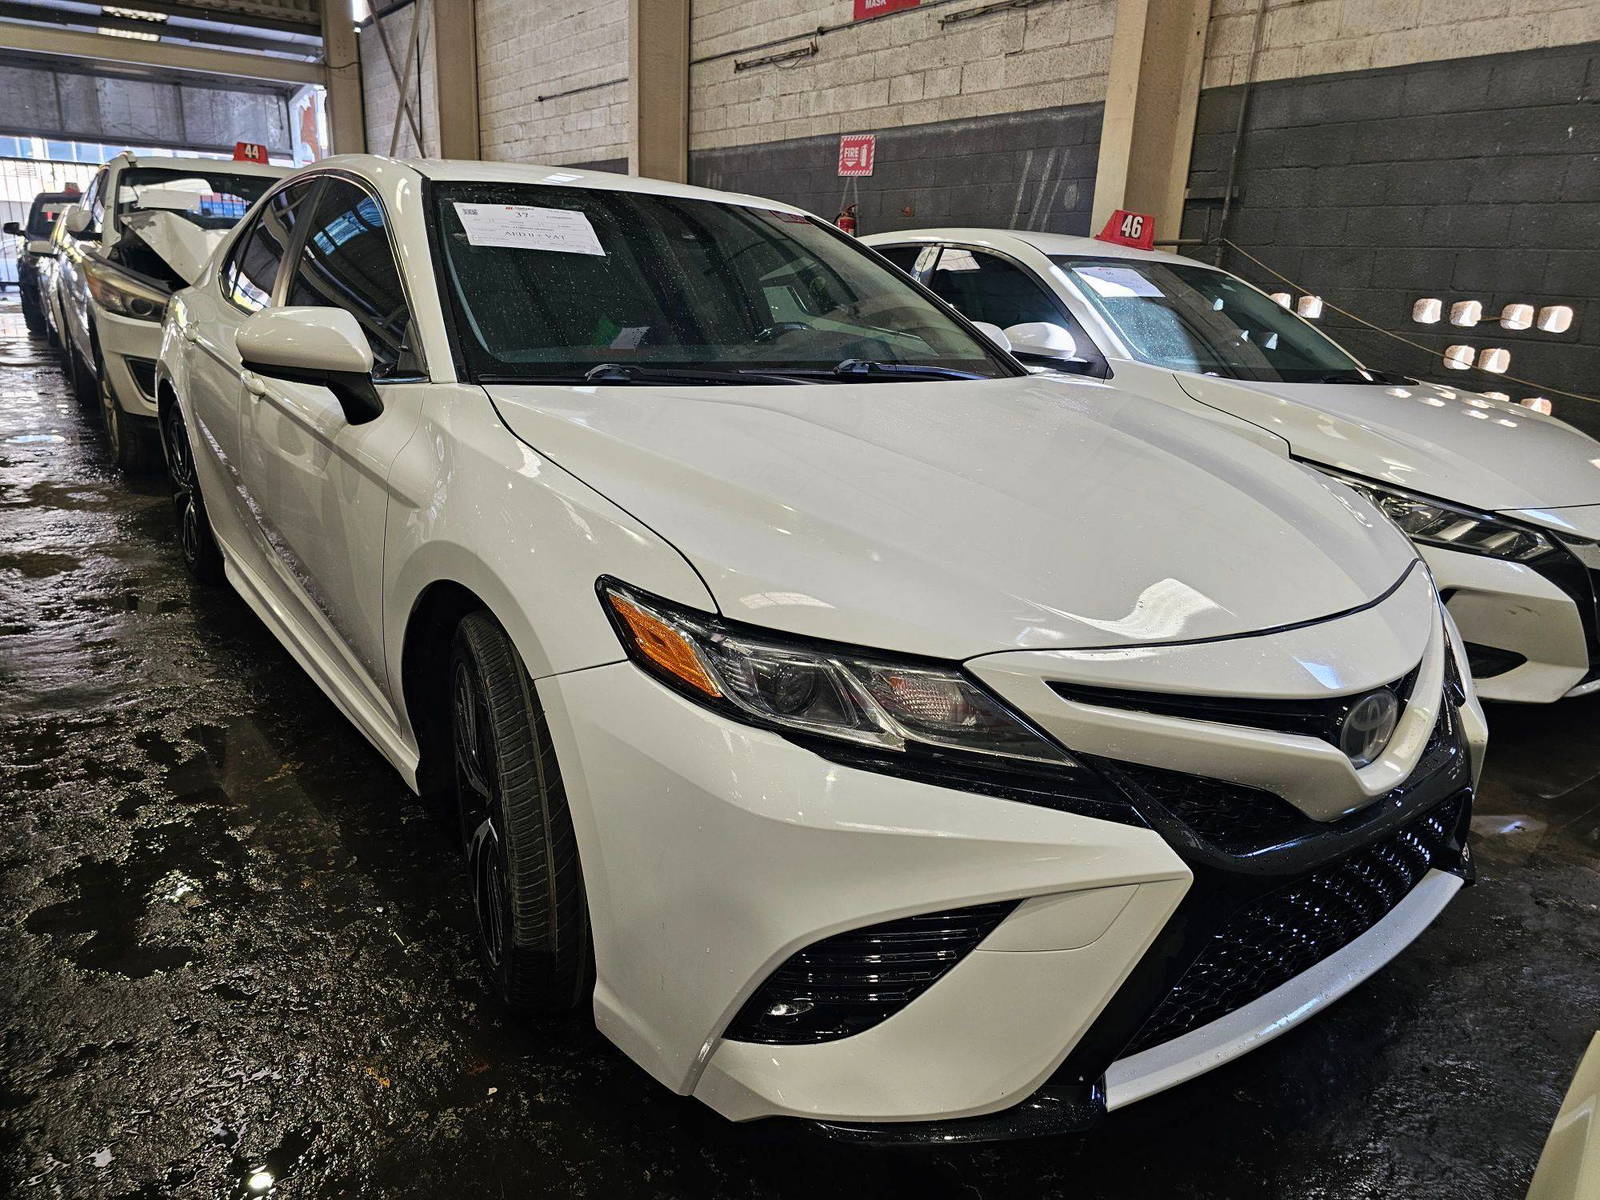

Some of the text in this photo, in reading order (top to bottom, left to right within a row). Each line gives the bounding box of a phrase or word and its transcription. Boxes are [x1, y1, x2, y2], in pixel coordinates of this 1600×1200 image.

[245, 144, 259, 160] 44
[845, 147, 859, 158] FIRE
[1121, 214, 1144, 238] 46
